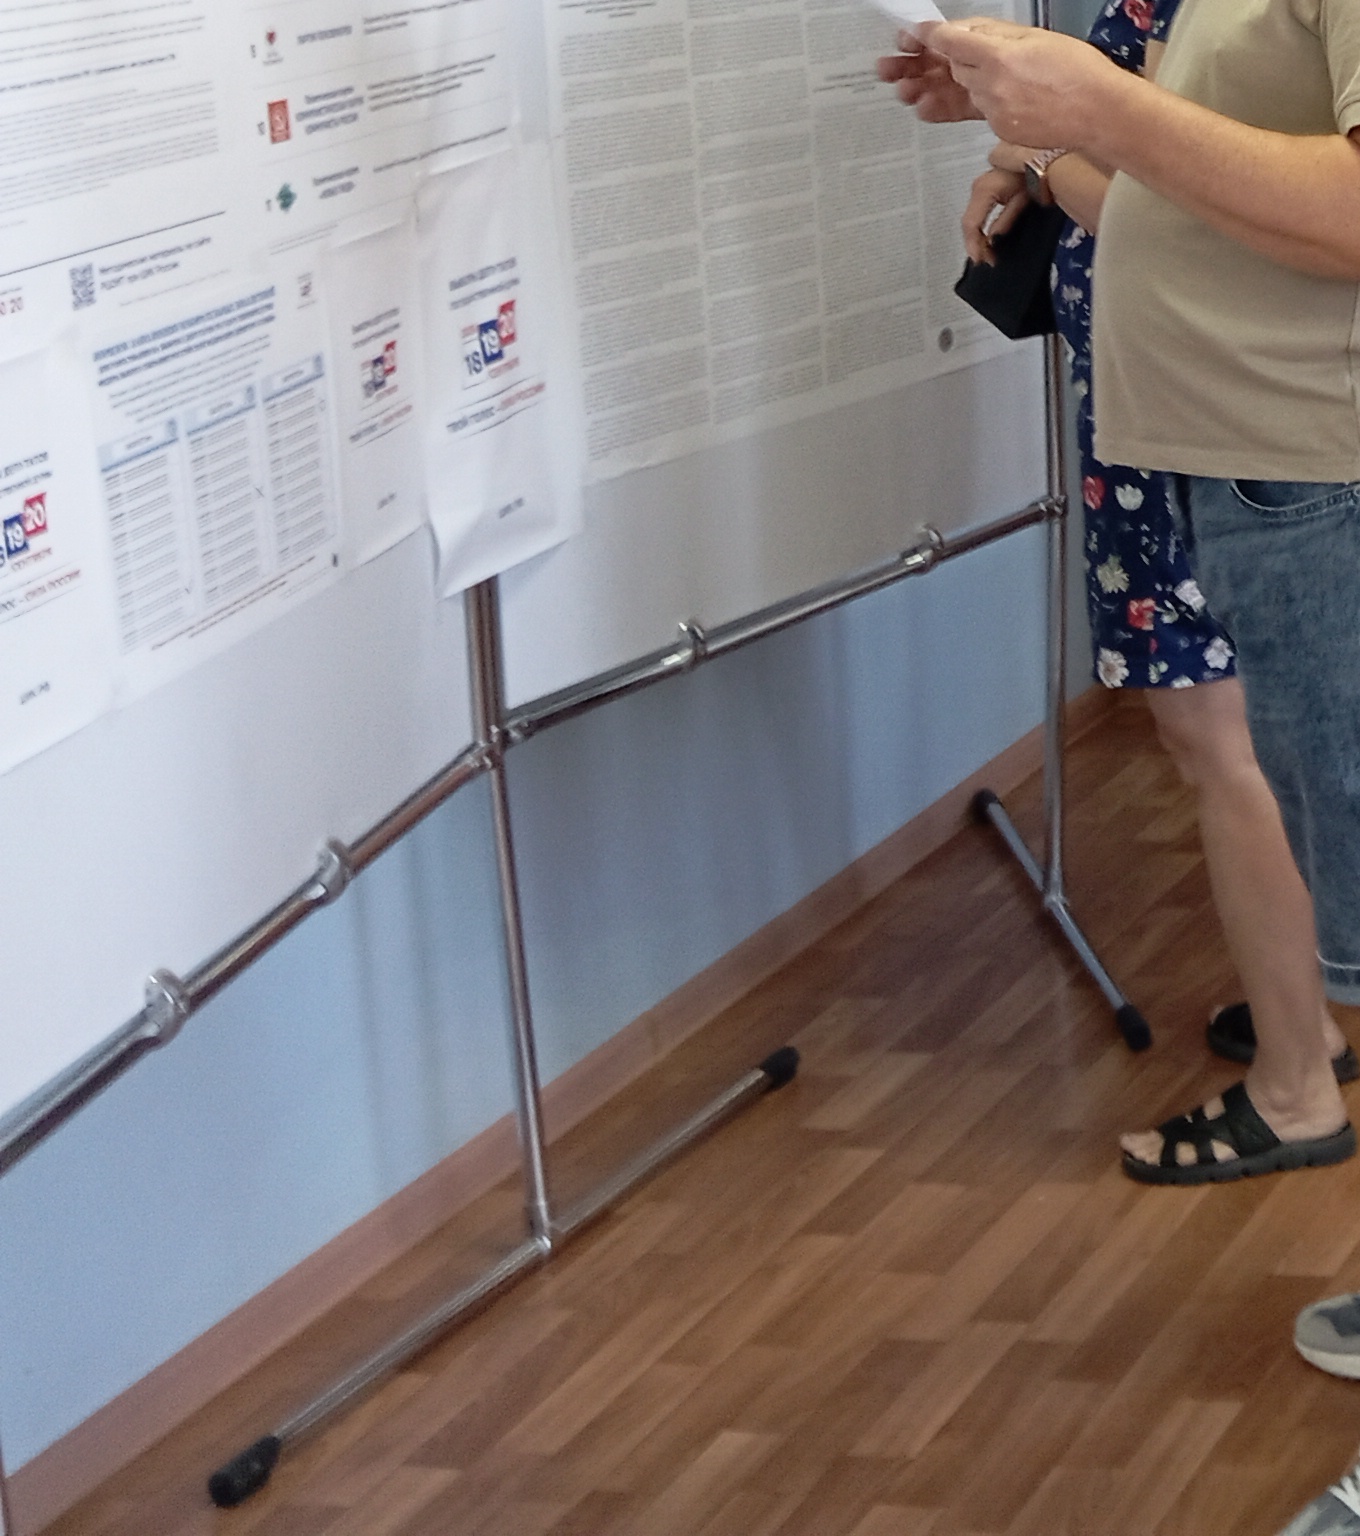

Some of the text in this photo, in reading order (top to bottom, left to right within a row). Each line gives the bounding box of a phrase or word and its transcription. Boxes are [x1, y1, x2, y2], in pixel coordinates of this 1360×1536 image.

[481, 328, 500, 357] 19
[26, 500, 46, 532] 20
[7, 522, 25, 552] 19
